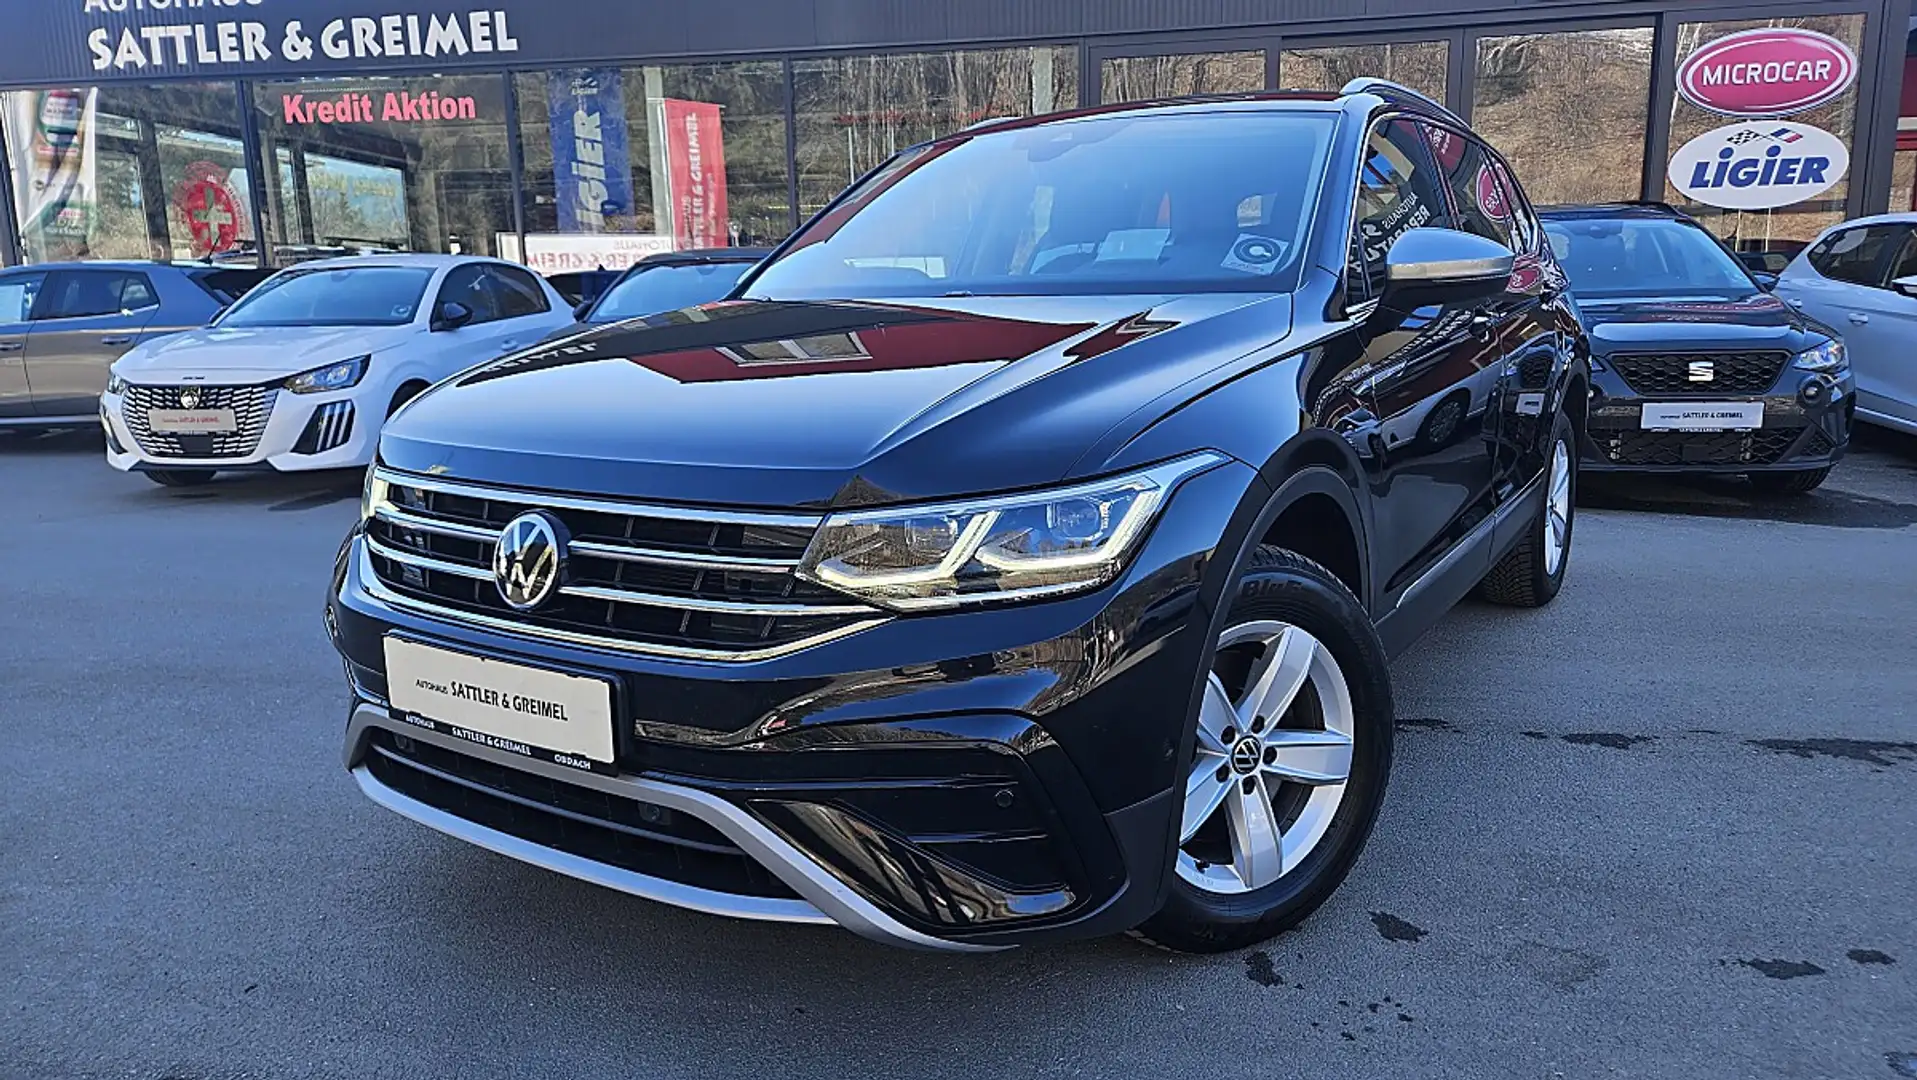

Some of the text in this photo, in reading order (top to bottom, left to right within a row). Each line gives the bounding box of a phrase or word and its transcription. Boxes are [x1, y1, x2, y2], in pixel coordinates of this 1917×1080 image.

[88, 10, 519, 71] SATTLER & GREIMEL
[1701, 59, 1832, 86] MICROCAR
[282, 90, 476, 124] Kredit Aktion
[1689, 145, 1830, 189] LIGIER
[450, 680, 499, 707] SATTLER
[501, 693, 510, 709] &
[512, 695, 569, 721] GREIMEL
[451, 727, 485, 744] SATTLER
[486, 736, 493, 746] &
[494, 738, 532, 756] GREIMEL
[554, 753, 591, 770] OBDACH
